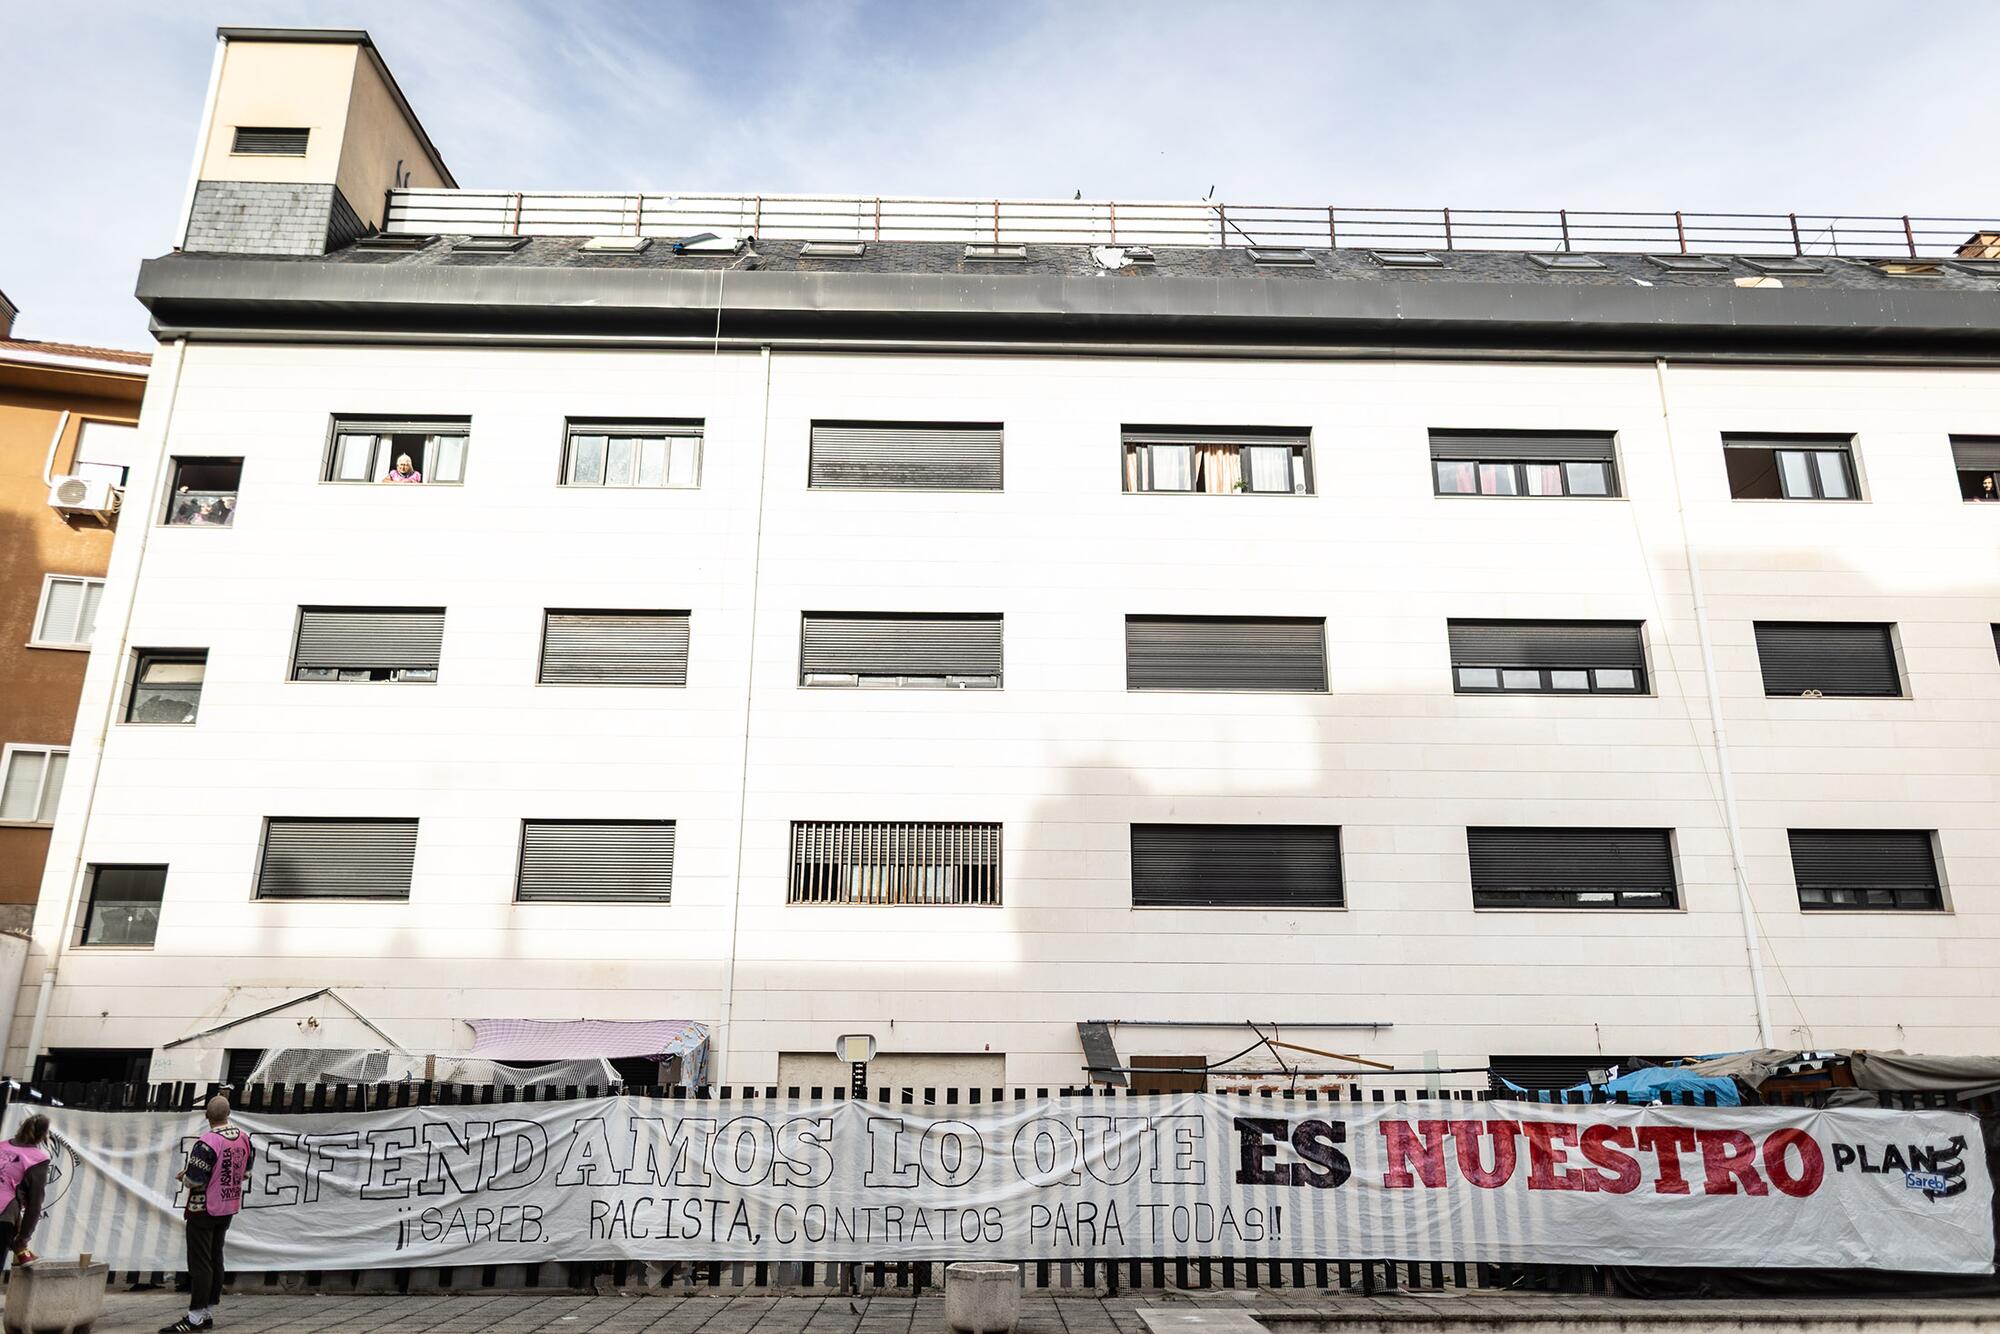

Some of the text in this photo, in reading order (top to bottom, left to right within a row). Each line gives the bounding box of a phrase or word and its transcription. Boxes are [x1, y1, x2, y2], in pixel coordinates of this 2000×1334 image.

[220, 1146, 233, 1187] ASAMBLEA
[863, 1116, 985, 1189] LO
[1012, 1114, 1206, 1187] QUE
[1233, 1116, 1352, 1190] ES
[1379, 1119, 1825, 1198] NUESTRO
[1831, 1143, 1938, 1174] PLAN
[1907, 1173, 1945, 1190] Sareb
[589, 1196, 761, 1246] RACISTA,
[774, 1202, 1004, 1244] CONTRATOS
[1030, 1198, 1126, 1247] PARA
[1136, 1201, 1282, 1244] TODAS!!
